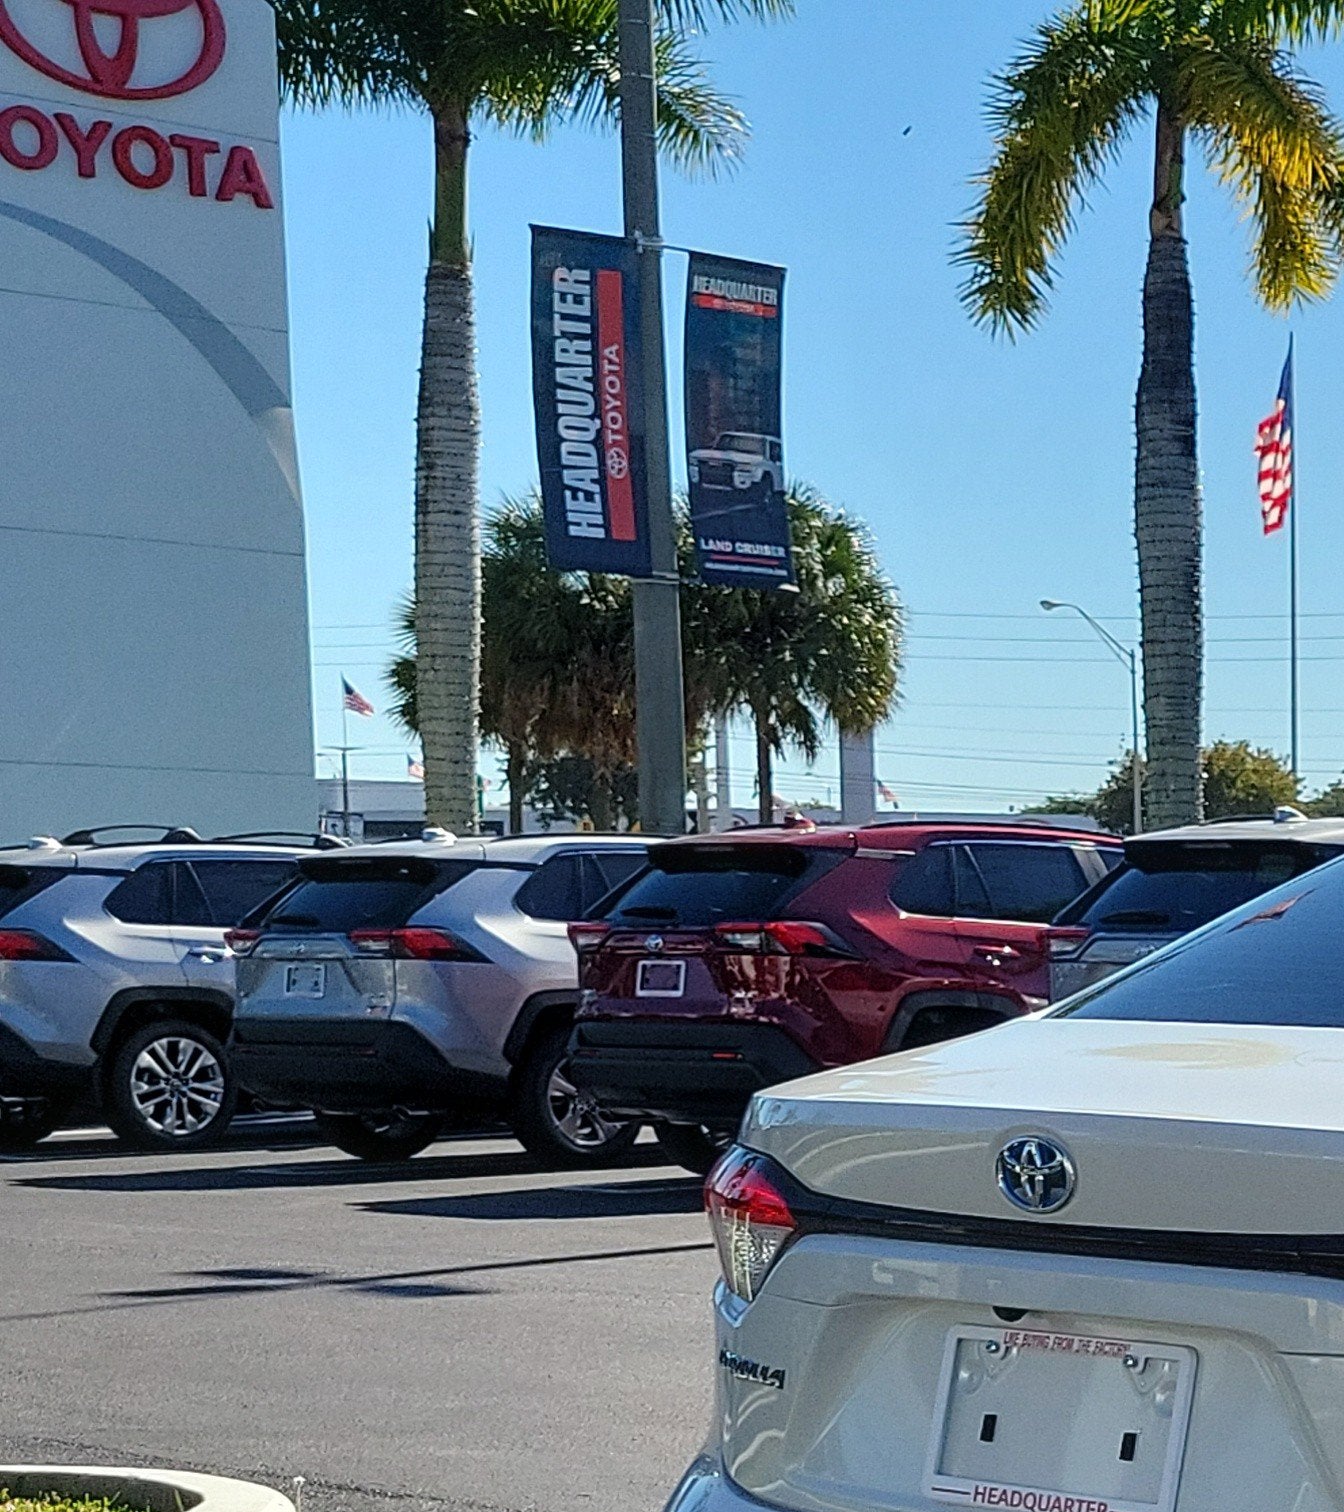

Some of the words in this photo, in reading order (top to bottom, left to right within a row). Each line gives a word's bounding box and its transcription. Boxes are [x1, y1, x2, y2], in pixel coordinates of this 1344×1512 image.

[0, 105, 274, 209] OYOTA
[552, 265, 607, 540] HEADQUARTER
[603, 343, 625, 444] TOYOTA
[700, 536, 733, 553] LAND
[735, 541, 787, 557] CRUISER
